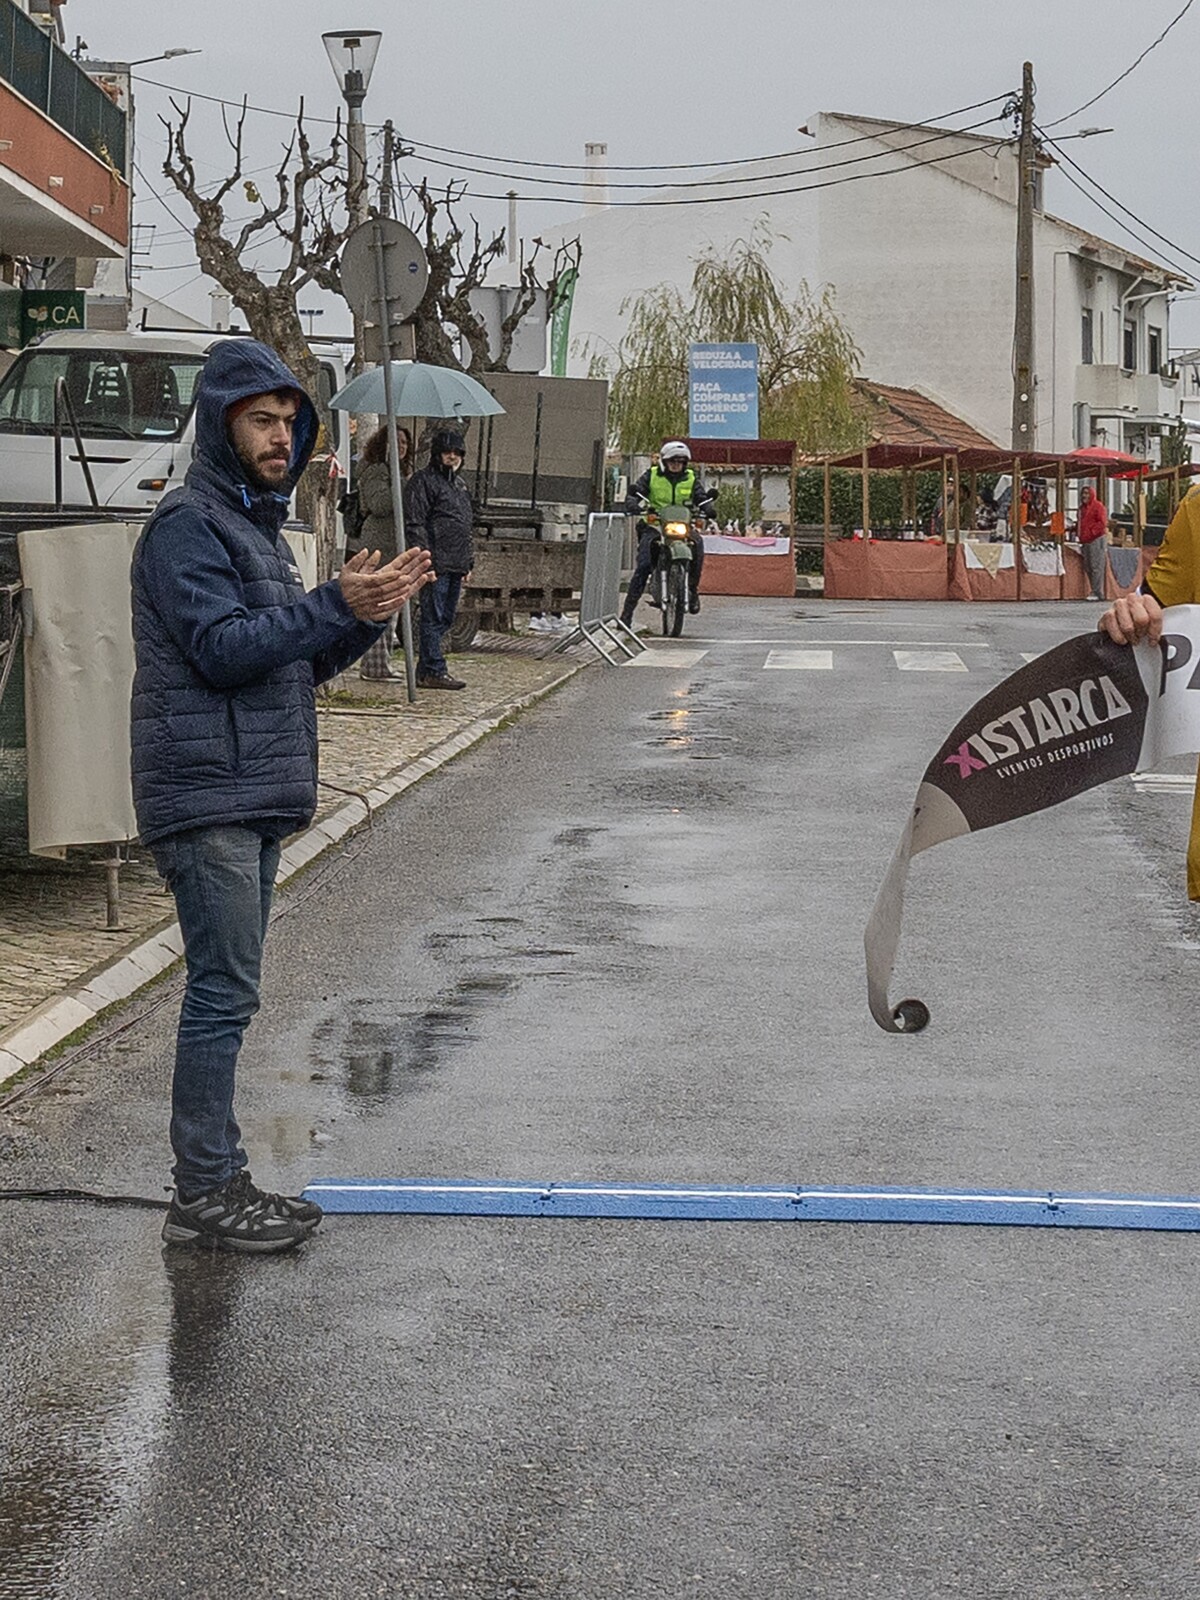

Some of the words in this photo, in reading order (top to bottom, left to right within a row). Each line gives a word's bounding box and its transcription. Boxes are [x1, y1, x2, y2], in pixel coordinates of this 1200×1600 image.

[52, 306, 80, 324] CA
[692, 351, 733, 360] REDUZA
[733, 351, 742, 360] A
[693, 360, 755, 369] VELOCIDADE
[693, 383, 721, 395] FAÇA
[693, 393, 746, 402] COMPRAS
[693, 401, 748, 412] COMÉRCIO
[693, 414, 727, 423] LOCAL
[943, 675, 1132, 779] XISTARCA
[996, 755, 1043, 779] EVENTOS
[1048, 732, 1115, 762] DESPORTIVOS
